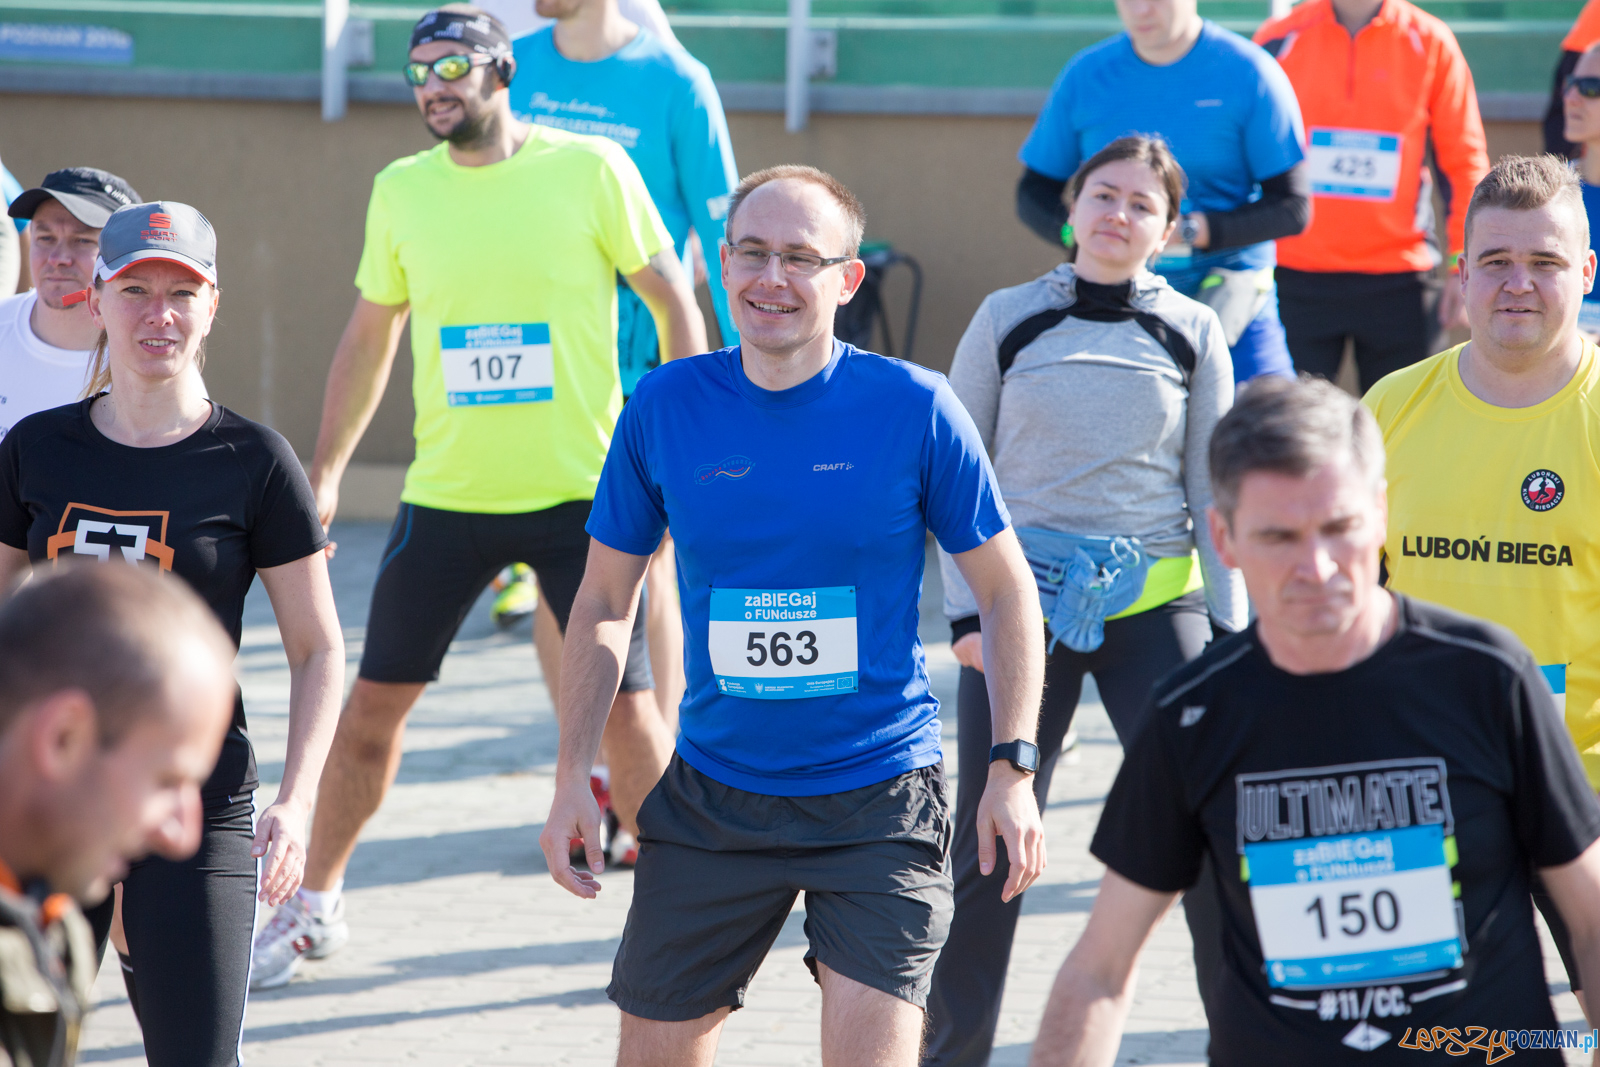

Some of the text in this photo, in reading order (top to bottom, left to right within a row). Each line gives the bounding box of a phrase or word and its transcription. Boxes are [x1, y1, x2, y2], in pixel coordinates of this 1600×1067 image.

[1331, 156, 1377, 178] 425
[470, 354, 522, 381] 107
[813, 463, 845, 471] CRAFT
[1523, 488, 1562, 510] KLUB BIEGACZA
[1402, 535, 1573, 567] LUBOŃ BIEGA
[744, 591, 817, 608] zaBIEGaj
[744, 608, 817, 620] o FUNdusze
[746, 630, 819, 667] 563
[1243, 768, 1446, 841] ULTIMATE
[1306, 889, 1400, 940] 150
